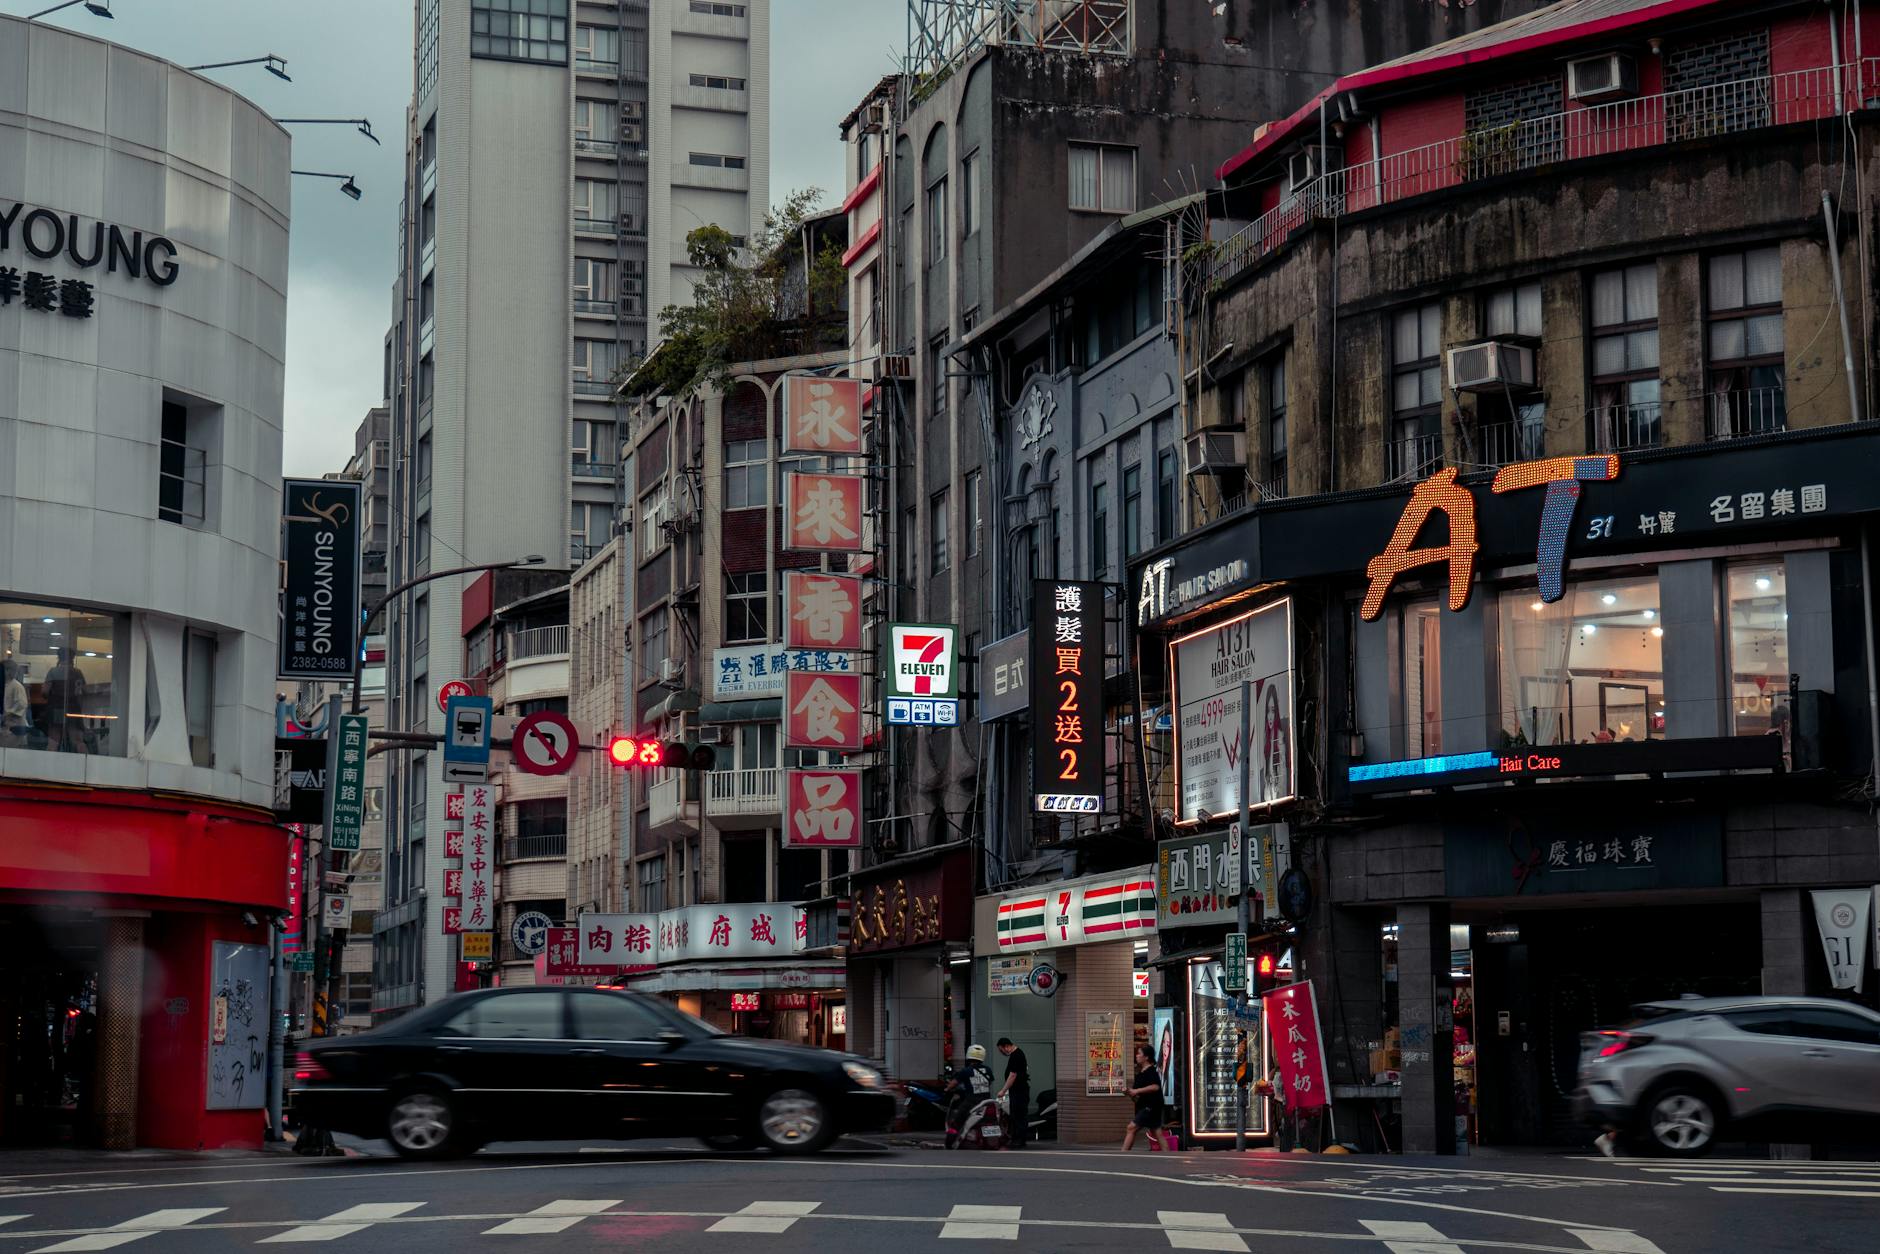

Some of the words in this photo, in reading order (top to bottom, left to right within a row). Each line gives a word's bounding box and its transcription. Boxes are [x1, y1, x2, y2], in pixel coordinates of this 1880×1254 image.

[1709, 483, 1828, 524] 名留集團
[1360, 454, 1620, 622] AT
[1586, 515, 1615, 540] 31
[312, 530, 334, 654] SUNYOUNG
[1138, 556, 1176, 627] AT
[1178, 575, 1206, 604] HAIR
[1206, 558, 1241, 592] SALON
[793, 383, 859, 841] 永來香食品
[292, 656, 346, 670] 2382-0588
[902, 635, 945, 694] 7
[994, 658, 1024, 696] 日式
[1211, 658, 1229, 678] HAIR
[1231, 647, 1255, 671] SALON
[1055, 586, 1083, 780] 護髮買2送2
[914, 703, 931, 711] ATM
[936, 709, 955, 717] Wi-Fi
[1201, 699, 1222, 728] 4999
[340, 731, 360, 801] 西寧南路
[1500, 757, 1524, 773] Hair
[1527, 752, 1561, 771] Care
[335, 816, 343, 824] S.
[468, 787, 490, 926] 宏安堂中藥房
[1548, 835, 1655, 867] 慶福珠寶
[588, 924, 652, 954] 肉粽
[1281, 1000, 1312, 1093] 木瓜牛奶
